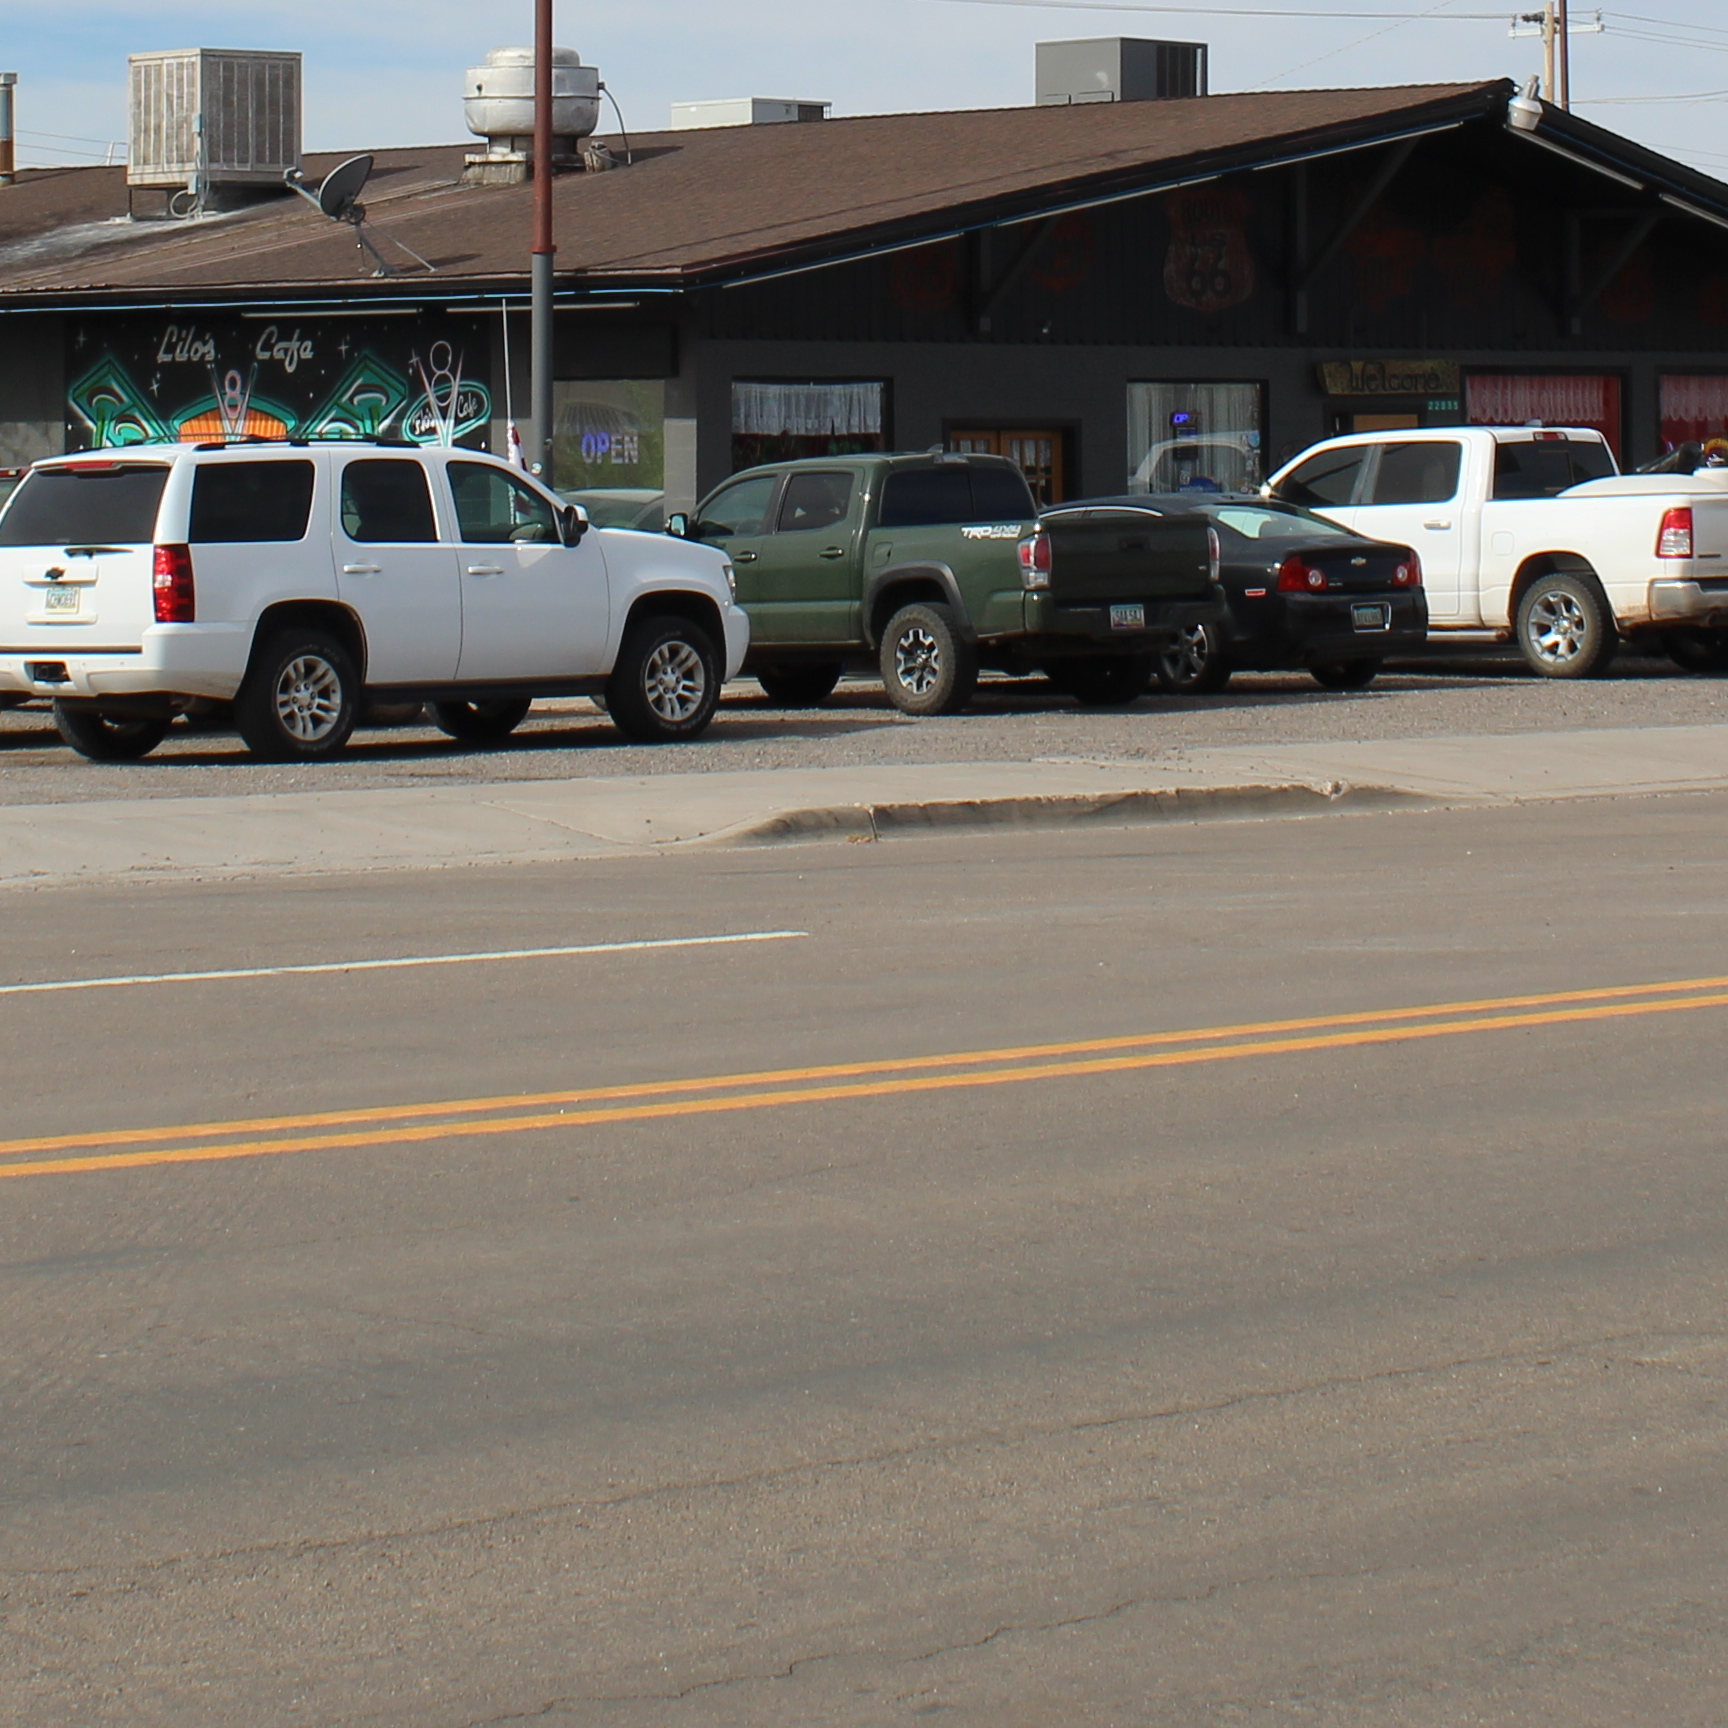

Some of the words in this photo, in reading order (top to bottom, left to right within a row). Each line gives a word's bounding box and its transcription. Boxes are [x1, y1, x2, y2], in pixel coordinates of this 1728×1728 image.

[1186, 249, 1233, 299] 66
[156, 324, 216, 363] Lilo's
[255, 325, 314, 373] Cafe
[581, 431, 639, 465] OPEN
[961, 526, 992, 540] TRD
